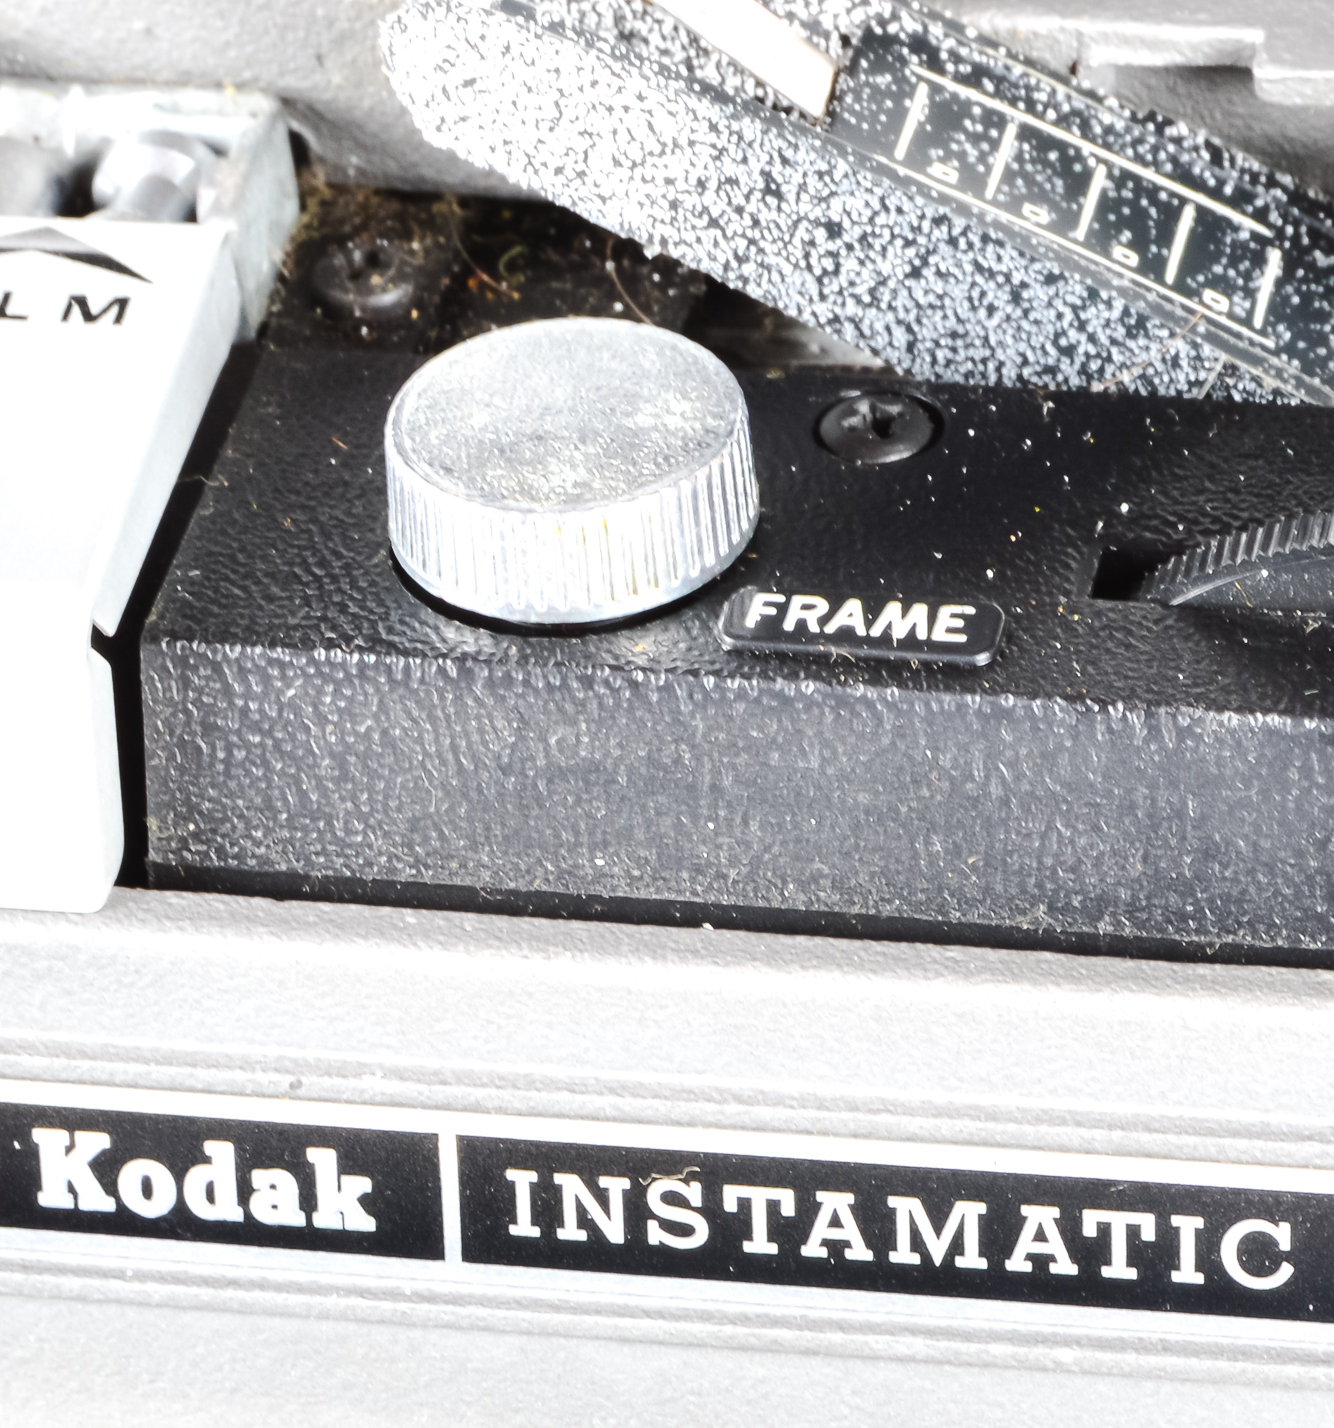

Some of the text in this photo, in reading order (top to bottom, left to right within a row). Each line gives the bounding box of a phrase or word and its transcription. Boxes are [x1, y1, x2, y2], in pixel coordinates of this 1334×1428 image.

[743, 592, 976, 647] FRAME
[32, 1126, 377, 1233] Kodak
[505, 1168, 1296, 1291] INSTAMATIC
